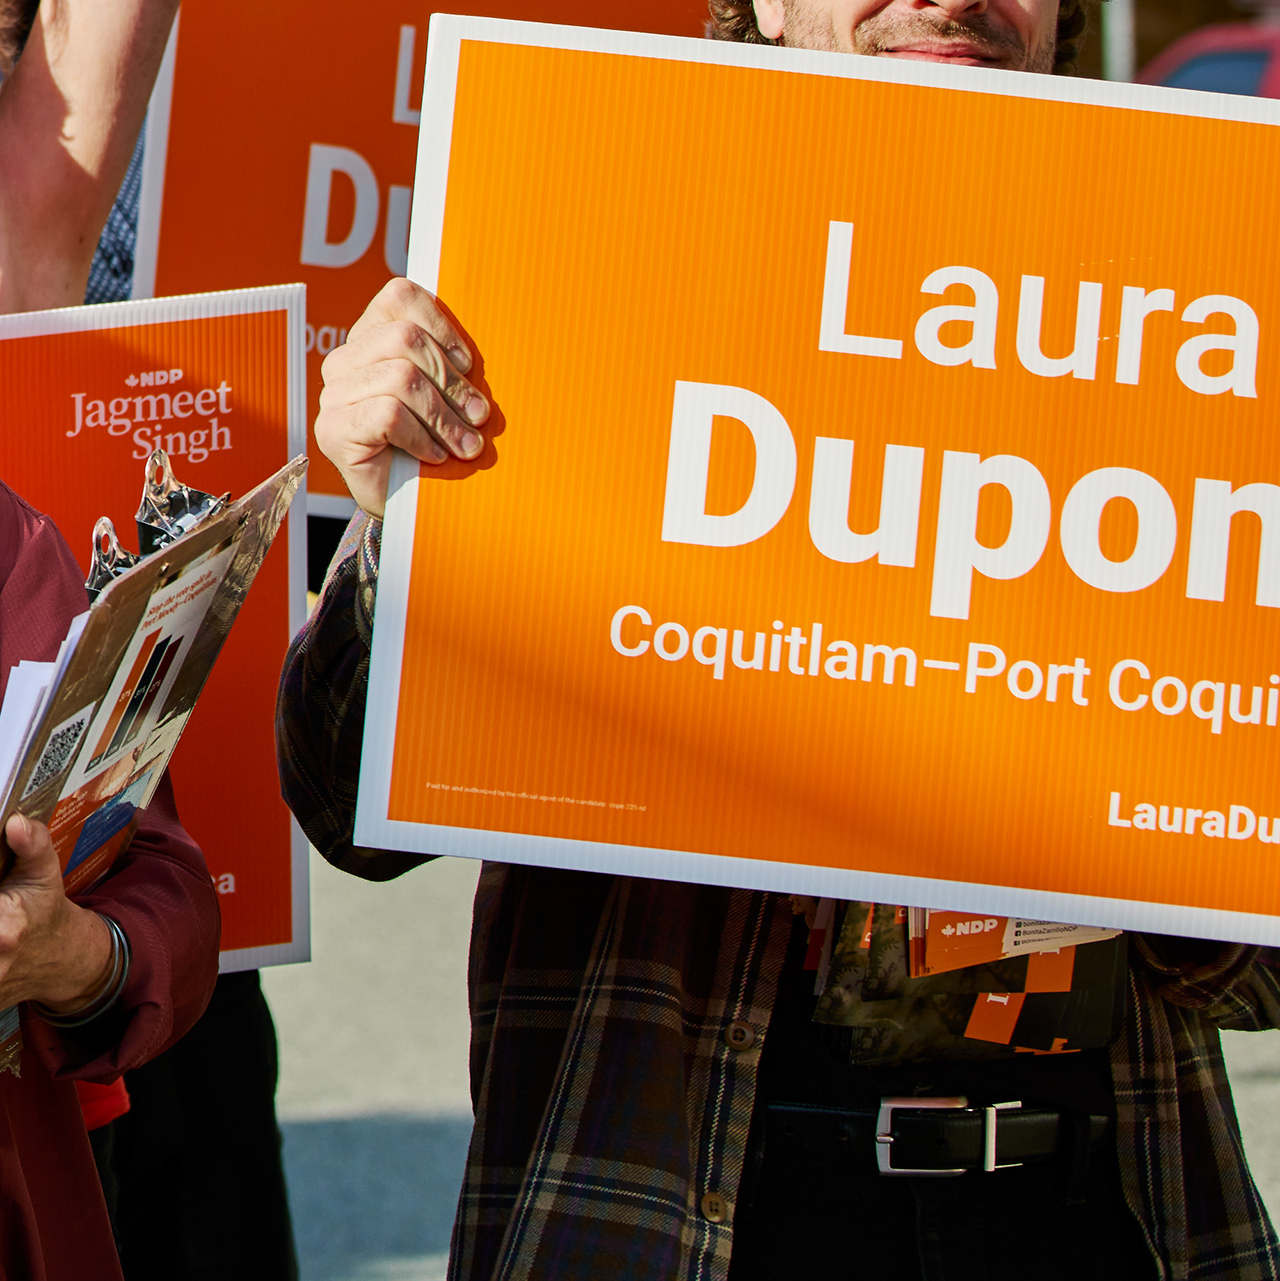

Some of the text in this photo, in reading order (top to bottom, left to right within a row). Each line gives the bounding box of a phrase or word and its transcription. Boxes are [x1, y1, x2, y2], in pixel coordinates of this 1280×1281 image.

[819, 220, 1262, 400] Laura
[140, 369, 183, 387] NDP
[66, 381, 232, 437] Jagmeet
[132, 418, 232, 464] Singh
[661, 380, 1280, 621] Dupon
[1108, 658, 1280, 735] Coqui
[956, 918, 998, 936] NDP
